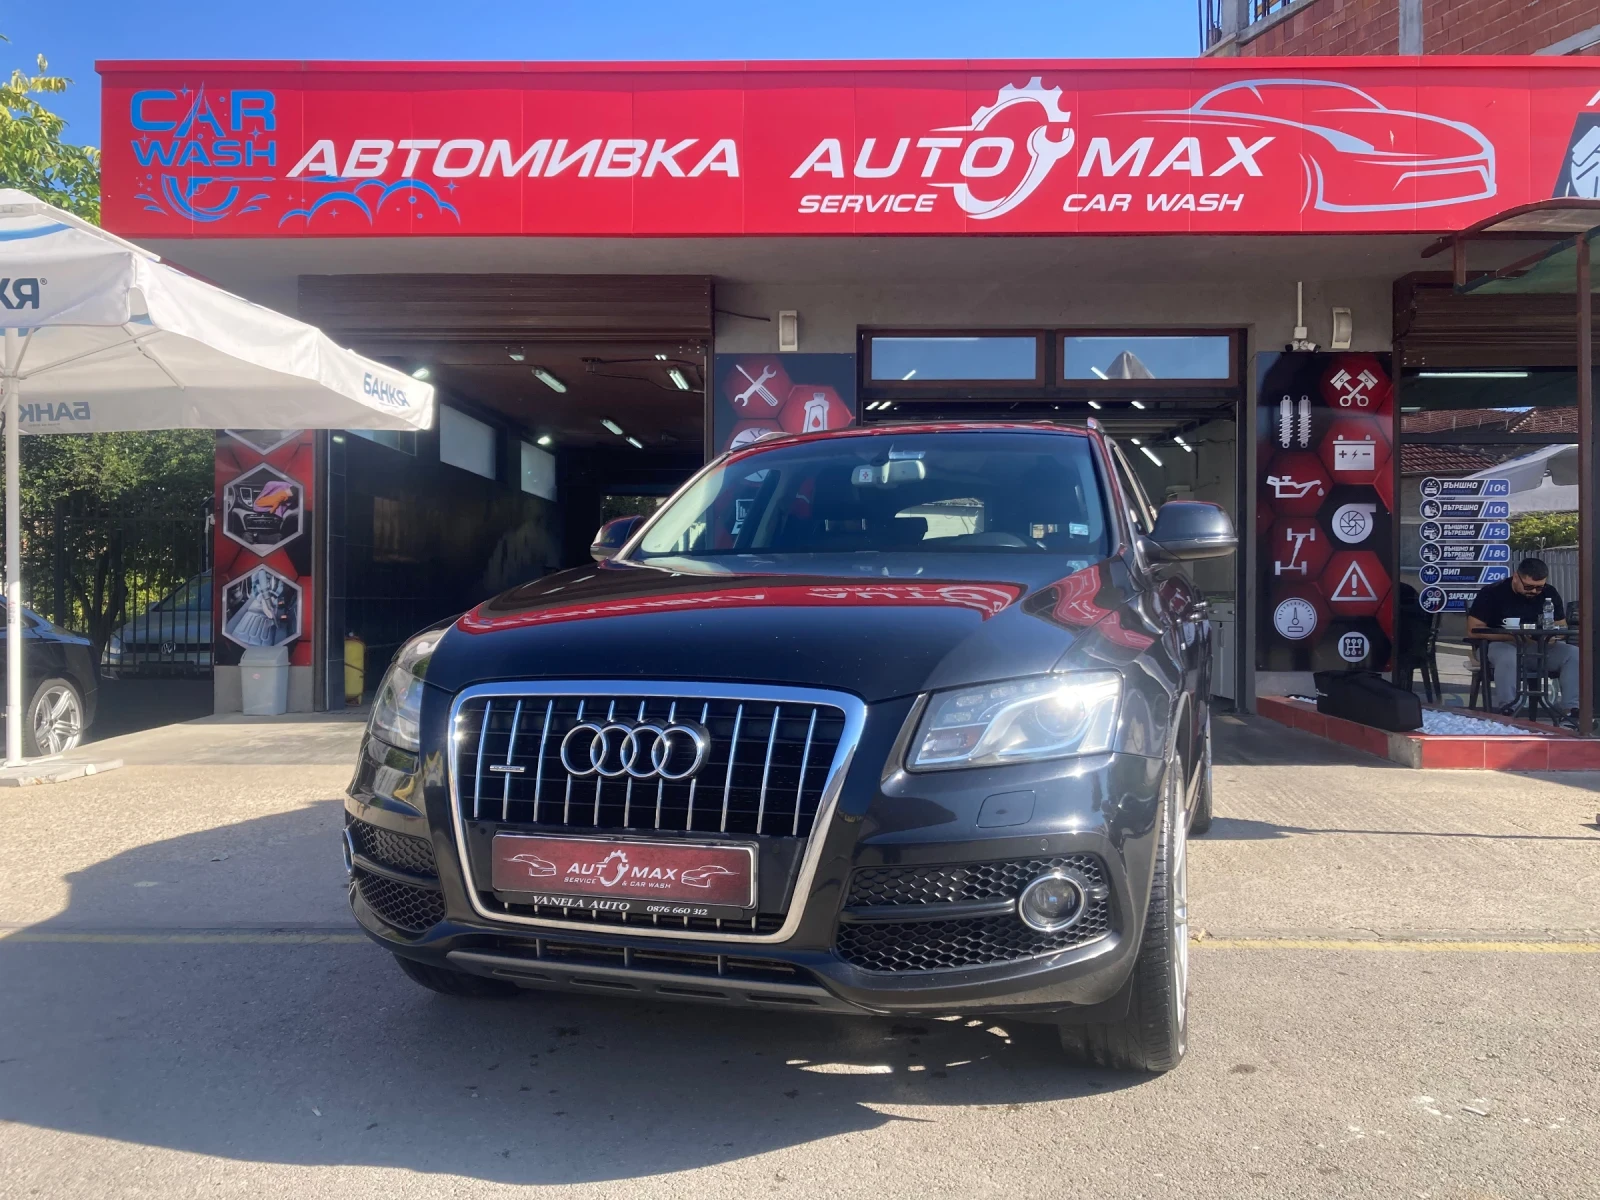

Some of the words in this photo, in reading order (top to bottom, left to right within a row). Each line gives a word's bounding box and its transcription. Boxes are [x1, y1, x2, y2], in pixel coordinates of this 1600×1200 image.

[130, 84, 276, 137] CAR
[131, 140, 276, 166] WASH
[286, 139, 740, 178] АВТОМИВКА
[789, 137, 1015, 178] AUTO
[1077, 136, 1276, 177] MAX
[798, 194, 938, 213] SERVICE
[1062, 194, 1132, 212] CAR
[1146, 193, 1244, 212] WASH
[1442, 481, 1478, 489] ВЪНШНО
[1488, 484, 1507, 492] 10€
[1488, 506, 1507, 514] 10€
[1488, 527, 1506, 536] 15€
[1488, 549, 1506, 558] 18€
[564, 877, 597, 885] SERVICE
[630, 866, 678, 881] MAX
[533, 895, 584, 908] VANELA
[588, 900, 630, 911] AUTO
[646, 905, 670, 913] 0876
[672, 907, 691, 915] 660
